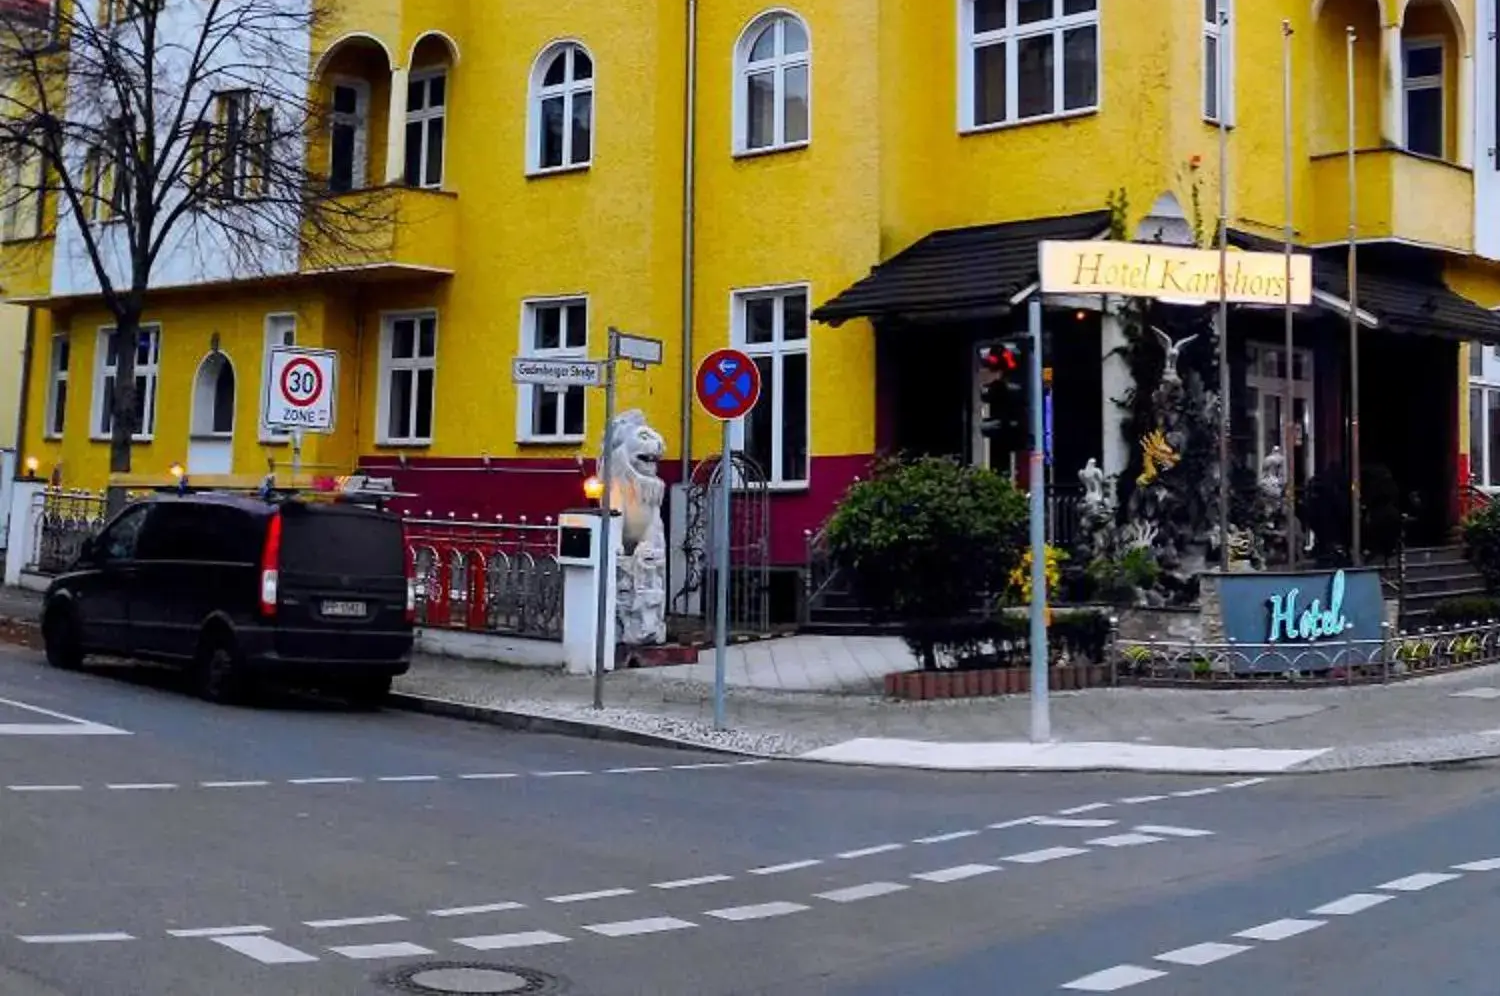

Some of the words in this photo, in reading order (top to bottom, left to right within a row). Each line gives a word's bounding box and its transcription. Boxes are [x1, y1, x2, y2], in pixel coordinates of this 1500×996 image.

[1072, 253, 1151, 289] Hotel
[1158, 259, 1295, 298] Karlshors
[289, 371, 315, 394] 30
[570, 365, 596, 382] Straße
[283, 409, 315, 422] ZONE
[1268, 569, 1346, 640] Hotel
